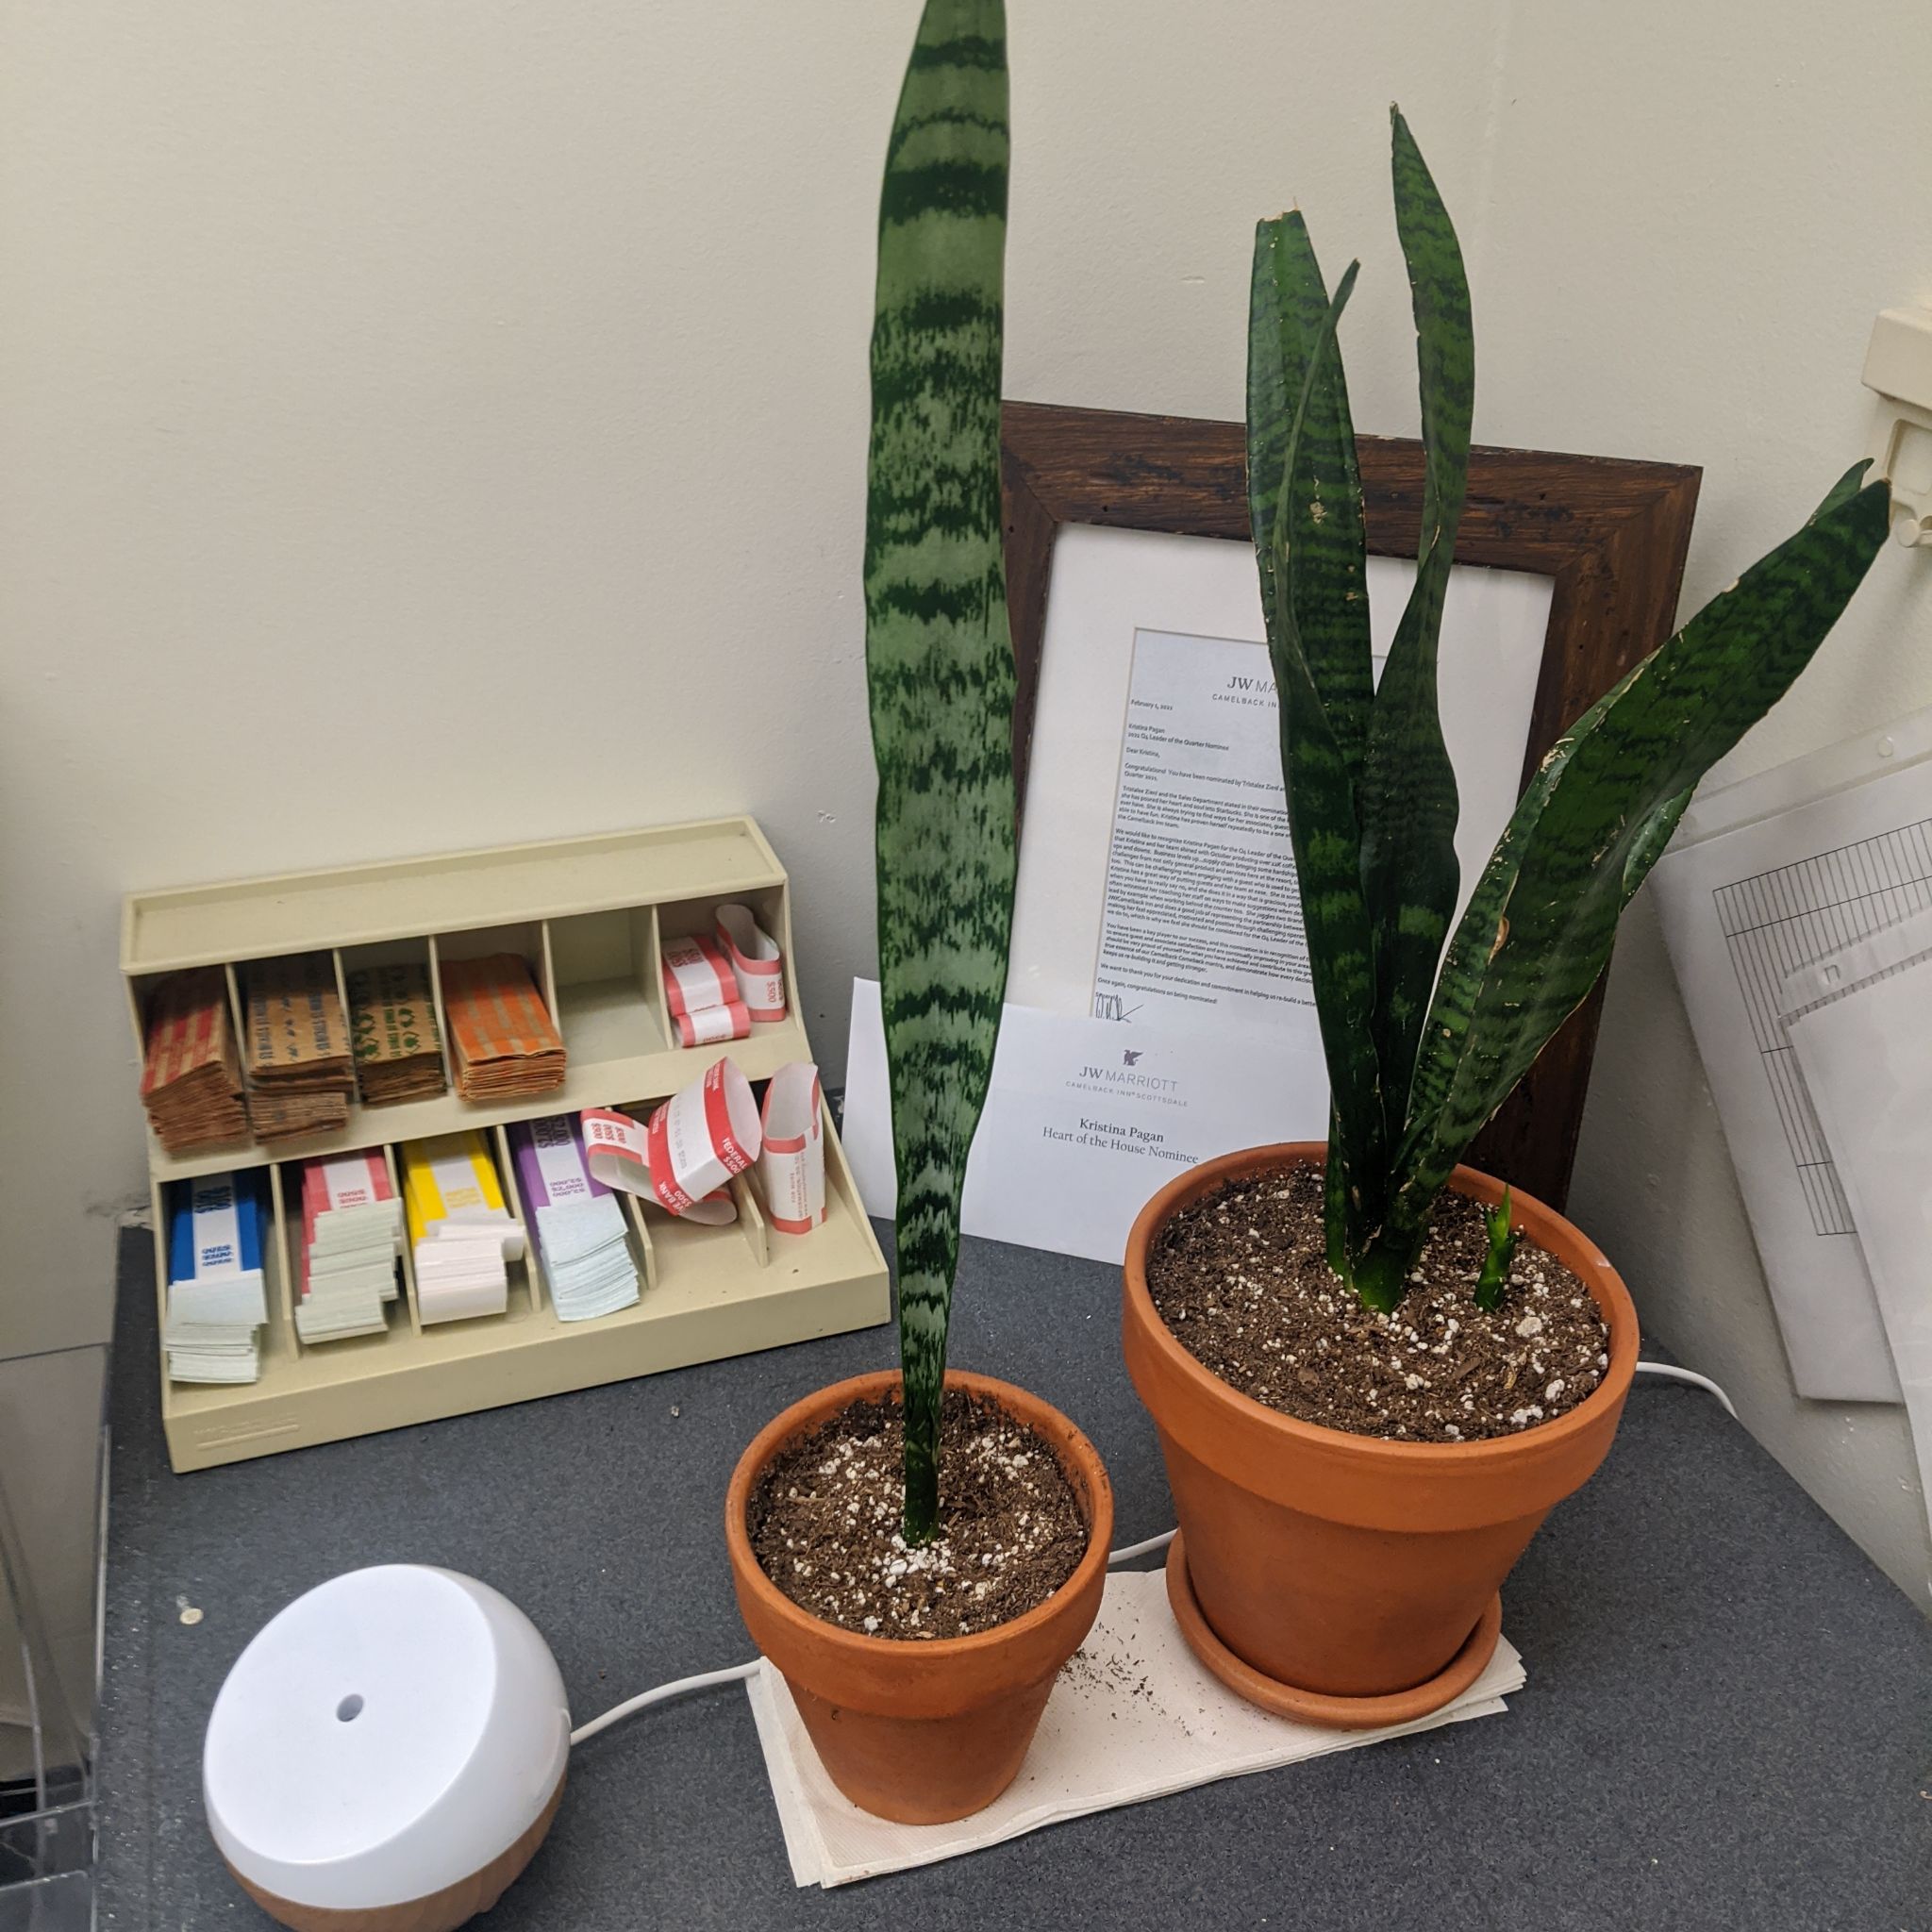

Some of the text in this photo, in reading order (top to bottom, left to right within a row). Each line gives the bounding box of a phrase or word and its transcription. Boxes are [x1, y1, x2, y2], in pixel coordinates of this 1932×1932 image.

[1227, 676, 1276, 693] JW MA
[1130, 699, 1154, 708] February
[1212, 693, 1264, 707] CAMELBACK
[1148, 725, 1165, 734] Pagan
[1139, 748, 1160, 758] Kristina,
[1183, 739, 1204, 747] Quarter
[1205, 741, 1229, 751] Nominee
[1124, 762, 1166, 775] Congratulations!
[1206, 774, 1234, 785] nominated
[1140, 795, 1158, 804] poured
[1216, 807, 1241, 815] Starbucks.
[1192, 796, 1223, 807] Department
[1126, 815, 1155, 824] Camelback
[1162, 806, 1179, 814] always
[1179, 808, 1195, 817] trying
[1245, 819, 1272, 828] associates,
[1274, 823, 1289, 831] guest
[1227, 824, 1255, 833] repeatedly
[1203, 841, 1219, 850] Pagan
[1102, 948, 1117, 958] keeps
[1166, 960, 1184, 970] getting
[1185, 963, 1208, 974] stronger.
[1111, 979, 1125, 989] again,
[1126, 982, 1165, 996] congratulations
[1173, 991, 1188, 1000] being
[1128, 967, 1142, 975] thank
[1174, 975, 1200, 986] dedication
[1211, 982, 1243, 994] commitment
[1249, 990, 1269, 1000] helping
[1065, 1081, 1113, 1093] CAMELBACK
[1079, 1066, 1178, 1091] JW MARRIOTT
[1079, 1118, 1164, 1142] Kristina Pagan
[723, 1137, 748, 1169] FEDERAL
[1042, 1126, 1199, 1164] Heart of the House Nominee
[724, 1157, 741, 1174] $500
[658, 1181, 684, 1214] VE BANK
[675, 1190, 691, 1207] $500
